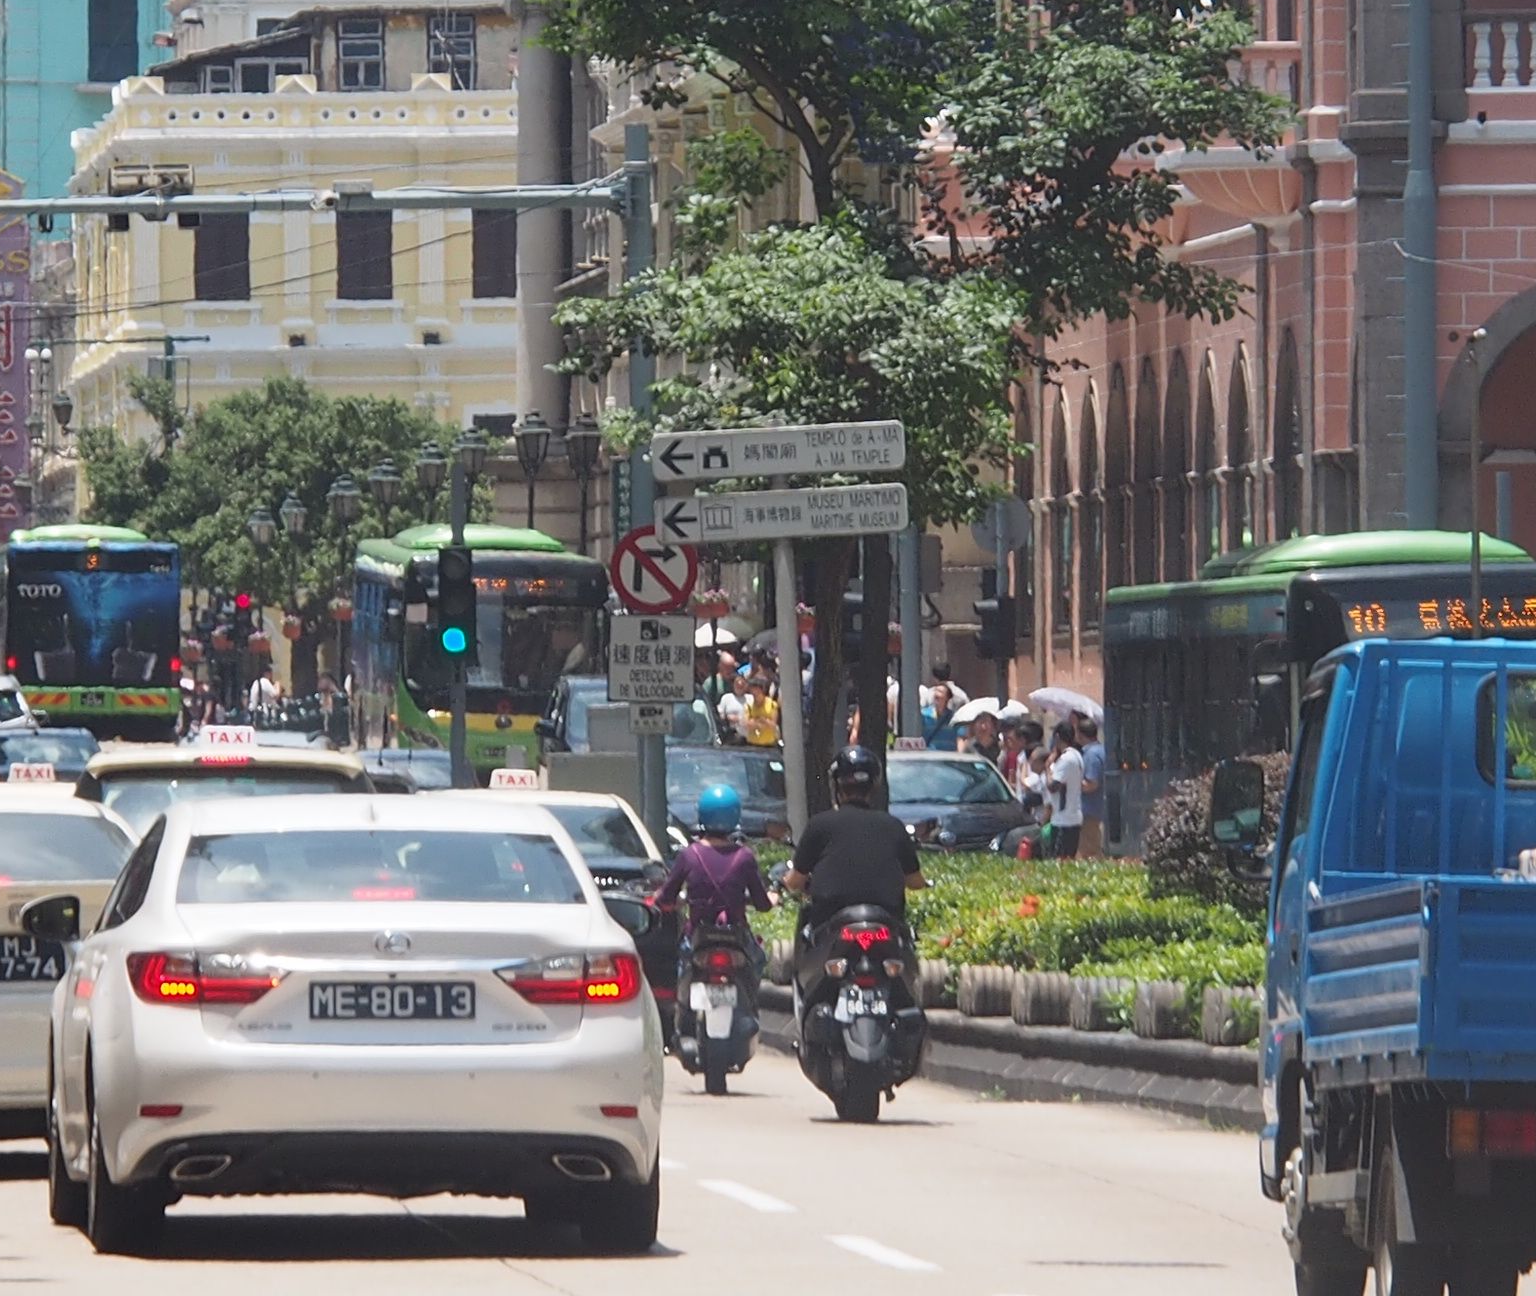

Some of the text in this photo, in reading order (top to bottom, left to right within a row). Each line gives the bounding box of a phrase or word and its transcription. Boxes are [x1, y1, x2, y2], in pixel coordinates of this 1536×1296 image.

[804, 430, 846, 447] TEMPLO
[851, 448, 891, 465] TEMPLE
[807, 492, 845, 511] MUSEU
[810, 510, 900, 530] MARITIME MUSEUM
[207, 730, 255, 745] TAXI
[897, 738, 924, 750] TAXI
[14, 764, 53, 780] TAXI
[497, 773, 536, 786] TAXI
[2, 935, 37, 958] MJ
[312, 984, 472, 1019] ME-80-13
